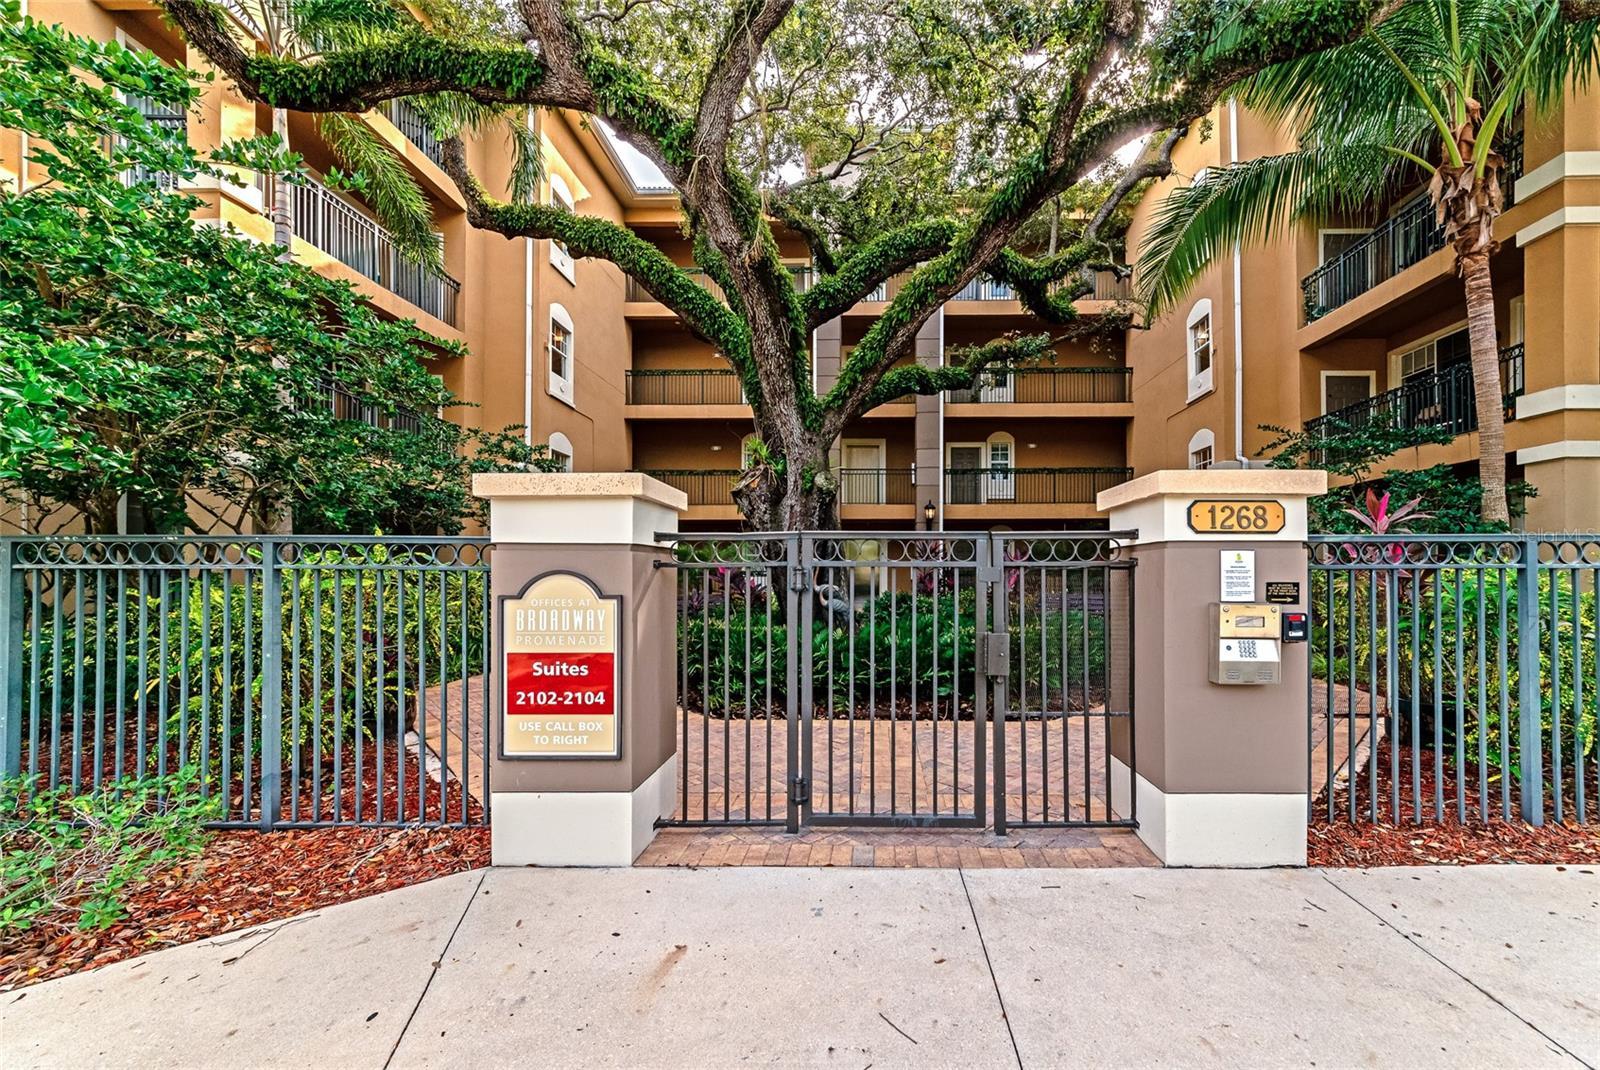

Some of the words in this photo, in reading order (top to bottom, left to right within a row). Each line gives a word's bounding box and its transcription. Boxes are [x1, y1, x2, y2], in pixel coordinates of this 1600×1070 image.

[1208, 505, 1269, 530] 1268
[531, 598, 573, 607] OFFICES
[579, 598, 591, 607] AT
[516, 608, 606, 632] BROADWAY
[516, 635, 606, 646] PROMENADE
[532, 661, 589, 677] Suites
[516, 691, 606, 705] 2102-2104
[519, 721, 541, 731] USE
[546, 721, 575, 731] CALL
[579, 721, 603, 731] BOX
[533, 735, 549, 745] TO
[553, 735, 588, 745] RIGHT
